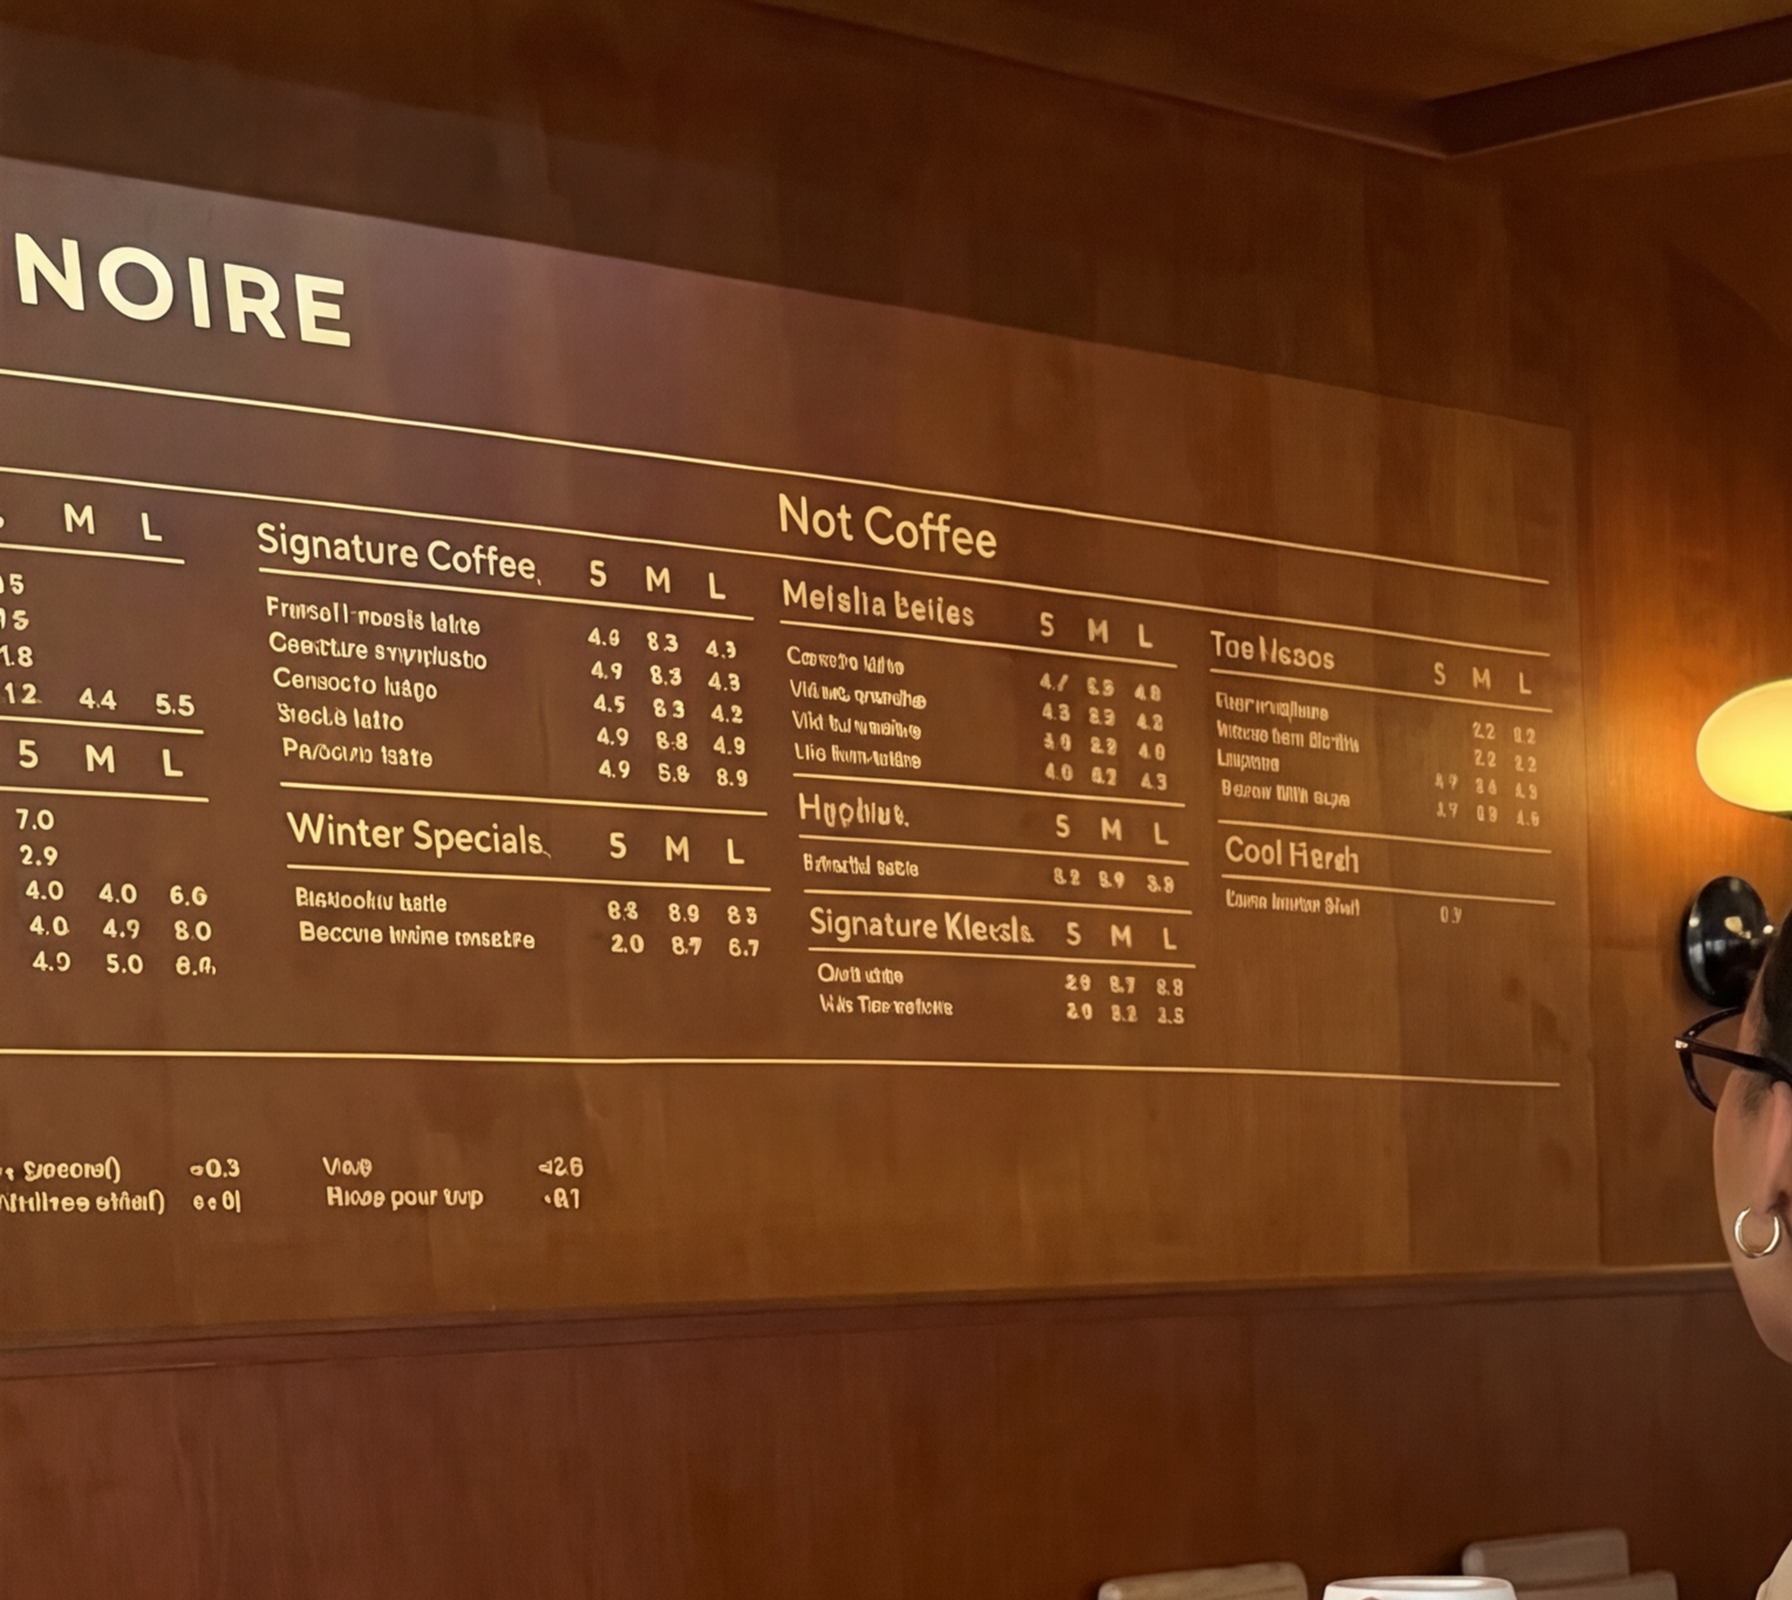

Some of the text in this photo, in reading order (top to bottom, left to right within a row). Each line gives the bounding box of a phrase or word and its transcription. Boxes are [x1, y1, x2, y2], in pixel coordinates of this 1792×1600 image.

[15, 233, 350, 347] NOIRE
[64, 503, 162, 542] M L
[779, 493, 997, 559] Not Coffee
[257, 523, 419, 568] Signature
[646, 566, 671, 593] M
[709, 572, 726, 600] L
[1040, 611, 1055, 637] S
[1087, 618, 1109, 643] M
[1138, 623, 1153, 648] L
[1434, 661, 1446, 686] S
[1472, 666, 1491, 690] M
[1519, 671, 1532, 694] L
[79, 687, 117, 710] 4.4
[156, 693, 195, 716] 5.5
[593, 693, 625, 713] 4.5
[597, 727, 629, 746] 4.9
[86, 744, 115, 773] M
[163, 749, 183, 777] L
[598, 759, 630, 778] 4.9
[16, 808, 54, 830] 7.0
[1056, 814, 1071, 838] S
[1101, 817, 1122, 841] M
[1154, 822, 1169, 845] L
[286, 811, 404, 849] Winter
[665, 835, 689, 863] M
[727, 838, 745, 864] L
[1225, 835, 1282, 866] Cool
[20, 845, 58, 866] 2.9
[25, 880, 64, 900] 4.0
[99, 883, 137, 904] 4.0
[810, 906, 938, 942] Signature
[1111, 924, 1132, 948] M
[1163, 927, 1177, 950] L
[106, 954, 143, 974] 5.0
